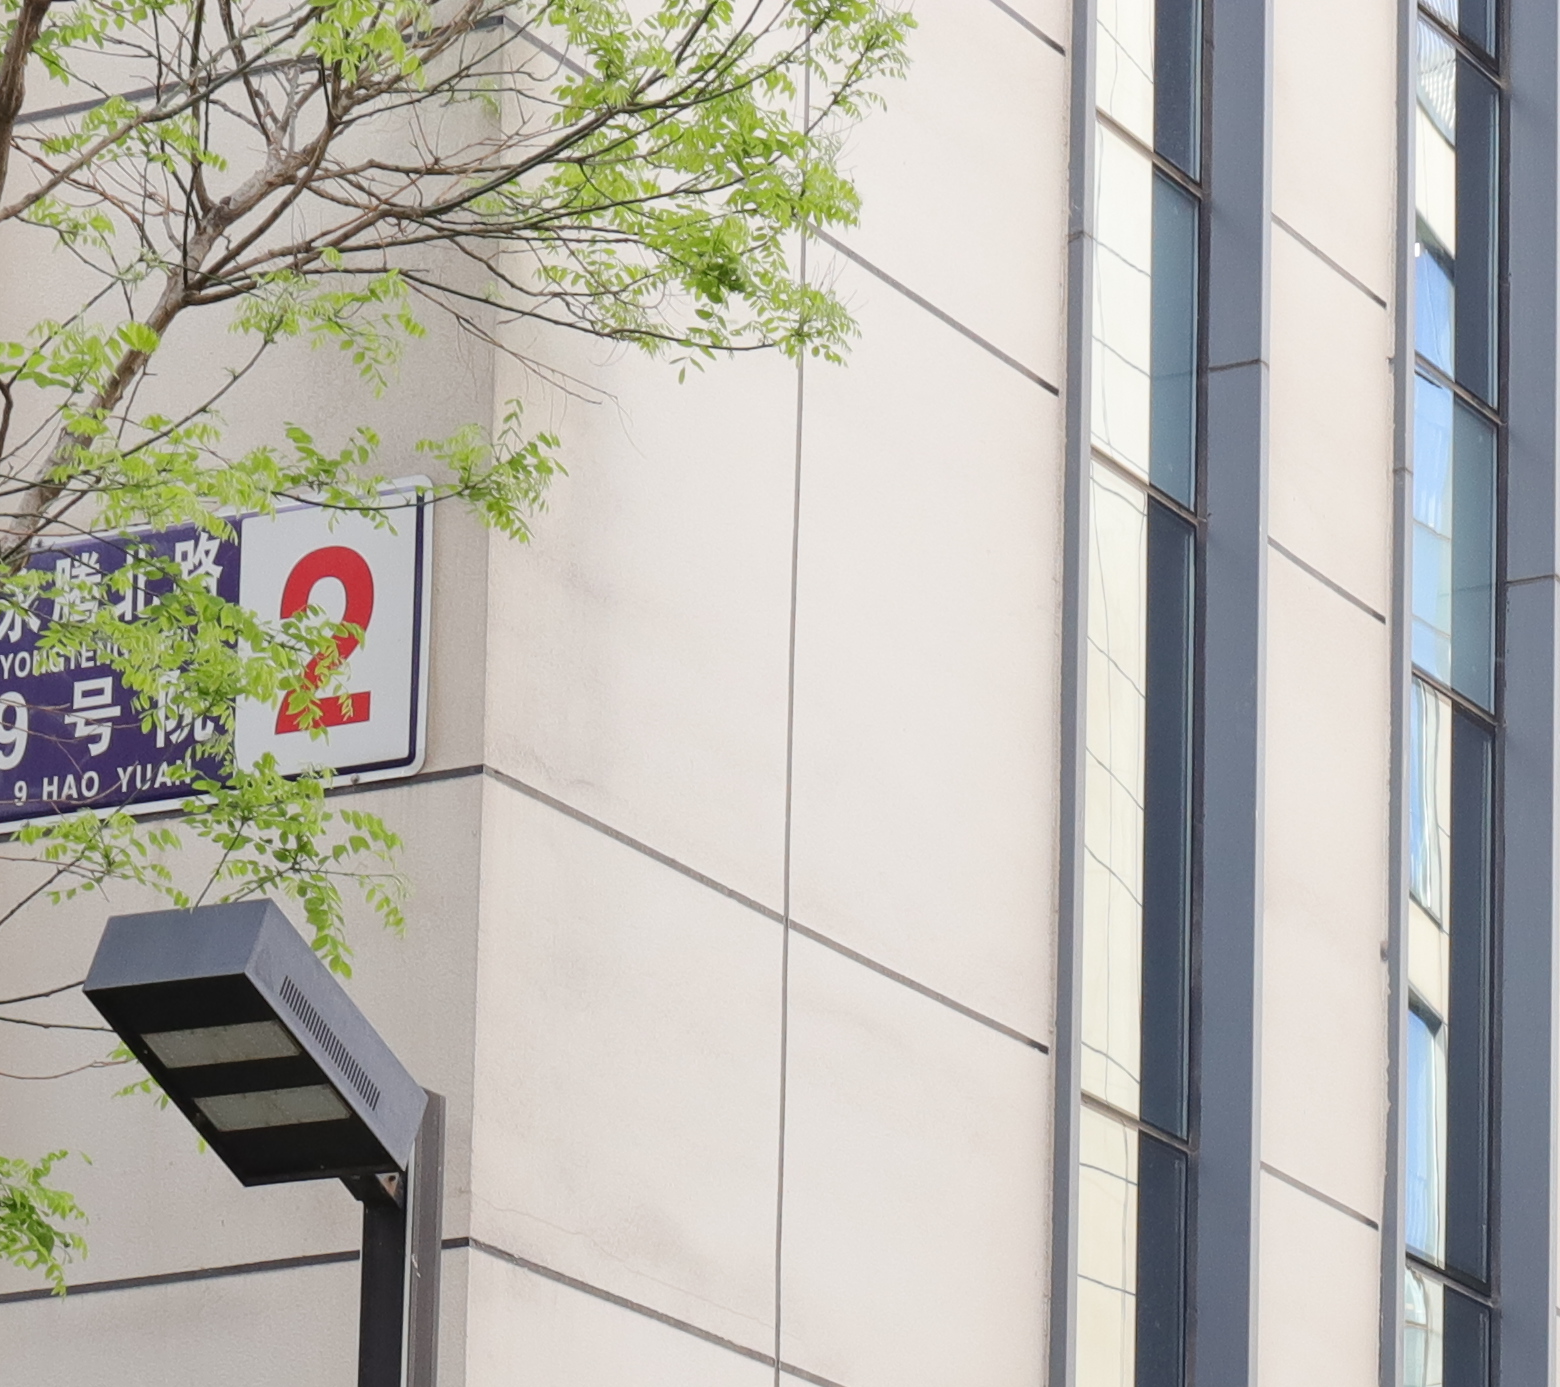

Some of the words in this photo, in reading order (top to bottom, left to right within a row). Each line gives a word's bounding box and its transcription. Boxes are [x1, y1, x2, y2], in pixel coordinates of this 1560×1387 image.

[274, 546, 374, 735] 2
[14, 780, 28, 806] 9
[42, 770, 100, 801] HAO
[117, 758, 192, 793] YUAN
